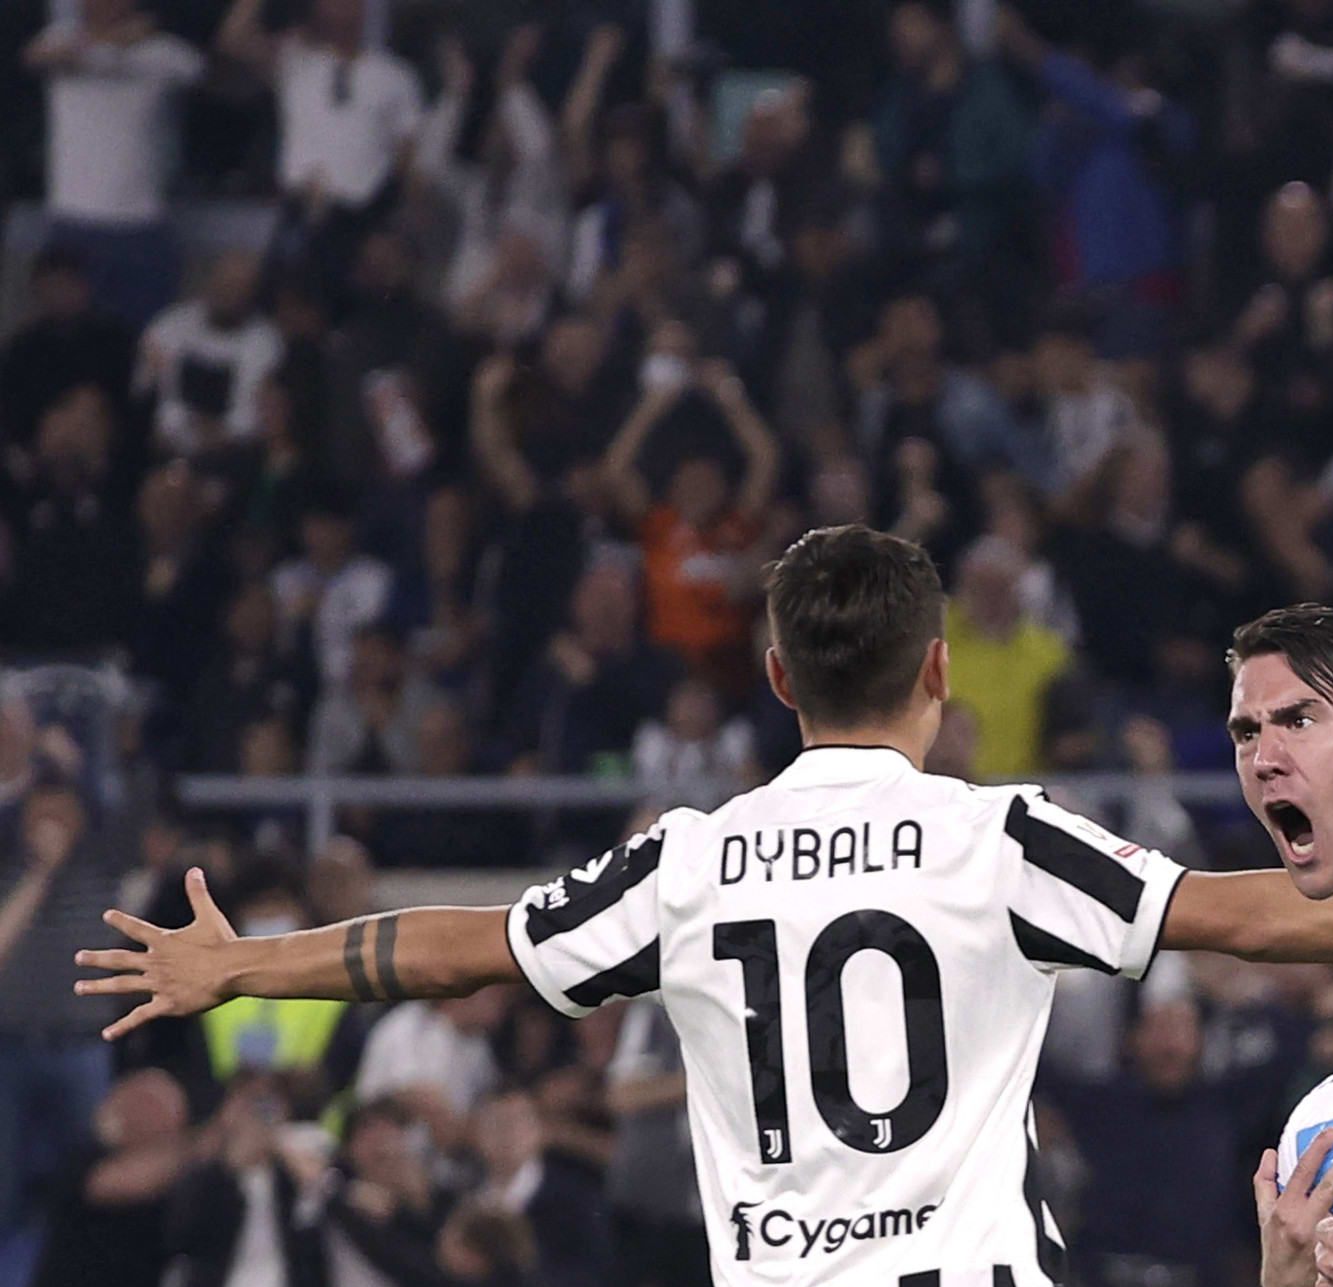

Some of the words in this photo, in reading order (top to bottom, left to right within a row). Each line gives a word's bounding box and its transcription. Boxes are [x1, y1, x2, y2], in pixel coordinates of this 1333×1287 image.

[720, 819, 922, 885] DYBALA
[712, 908, 949, 1164] 10
[760, 1203, 938, 1258] Cygame
